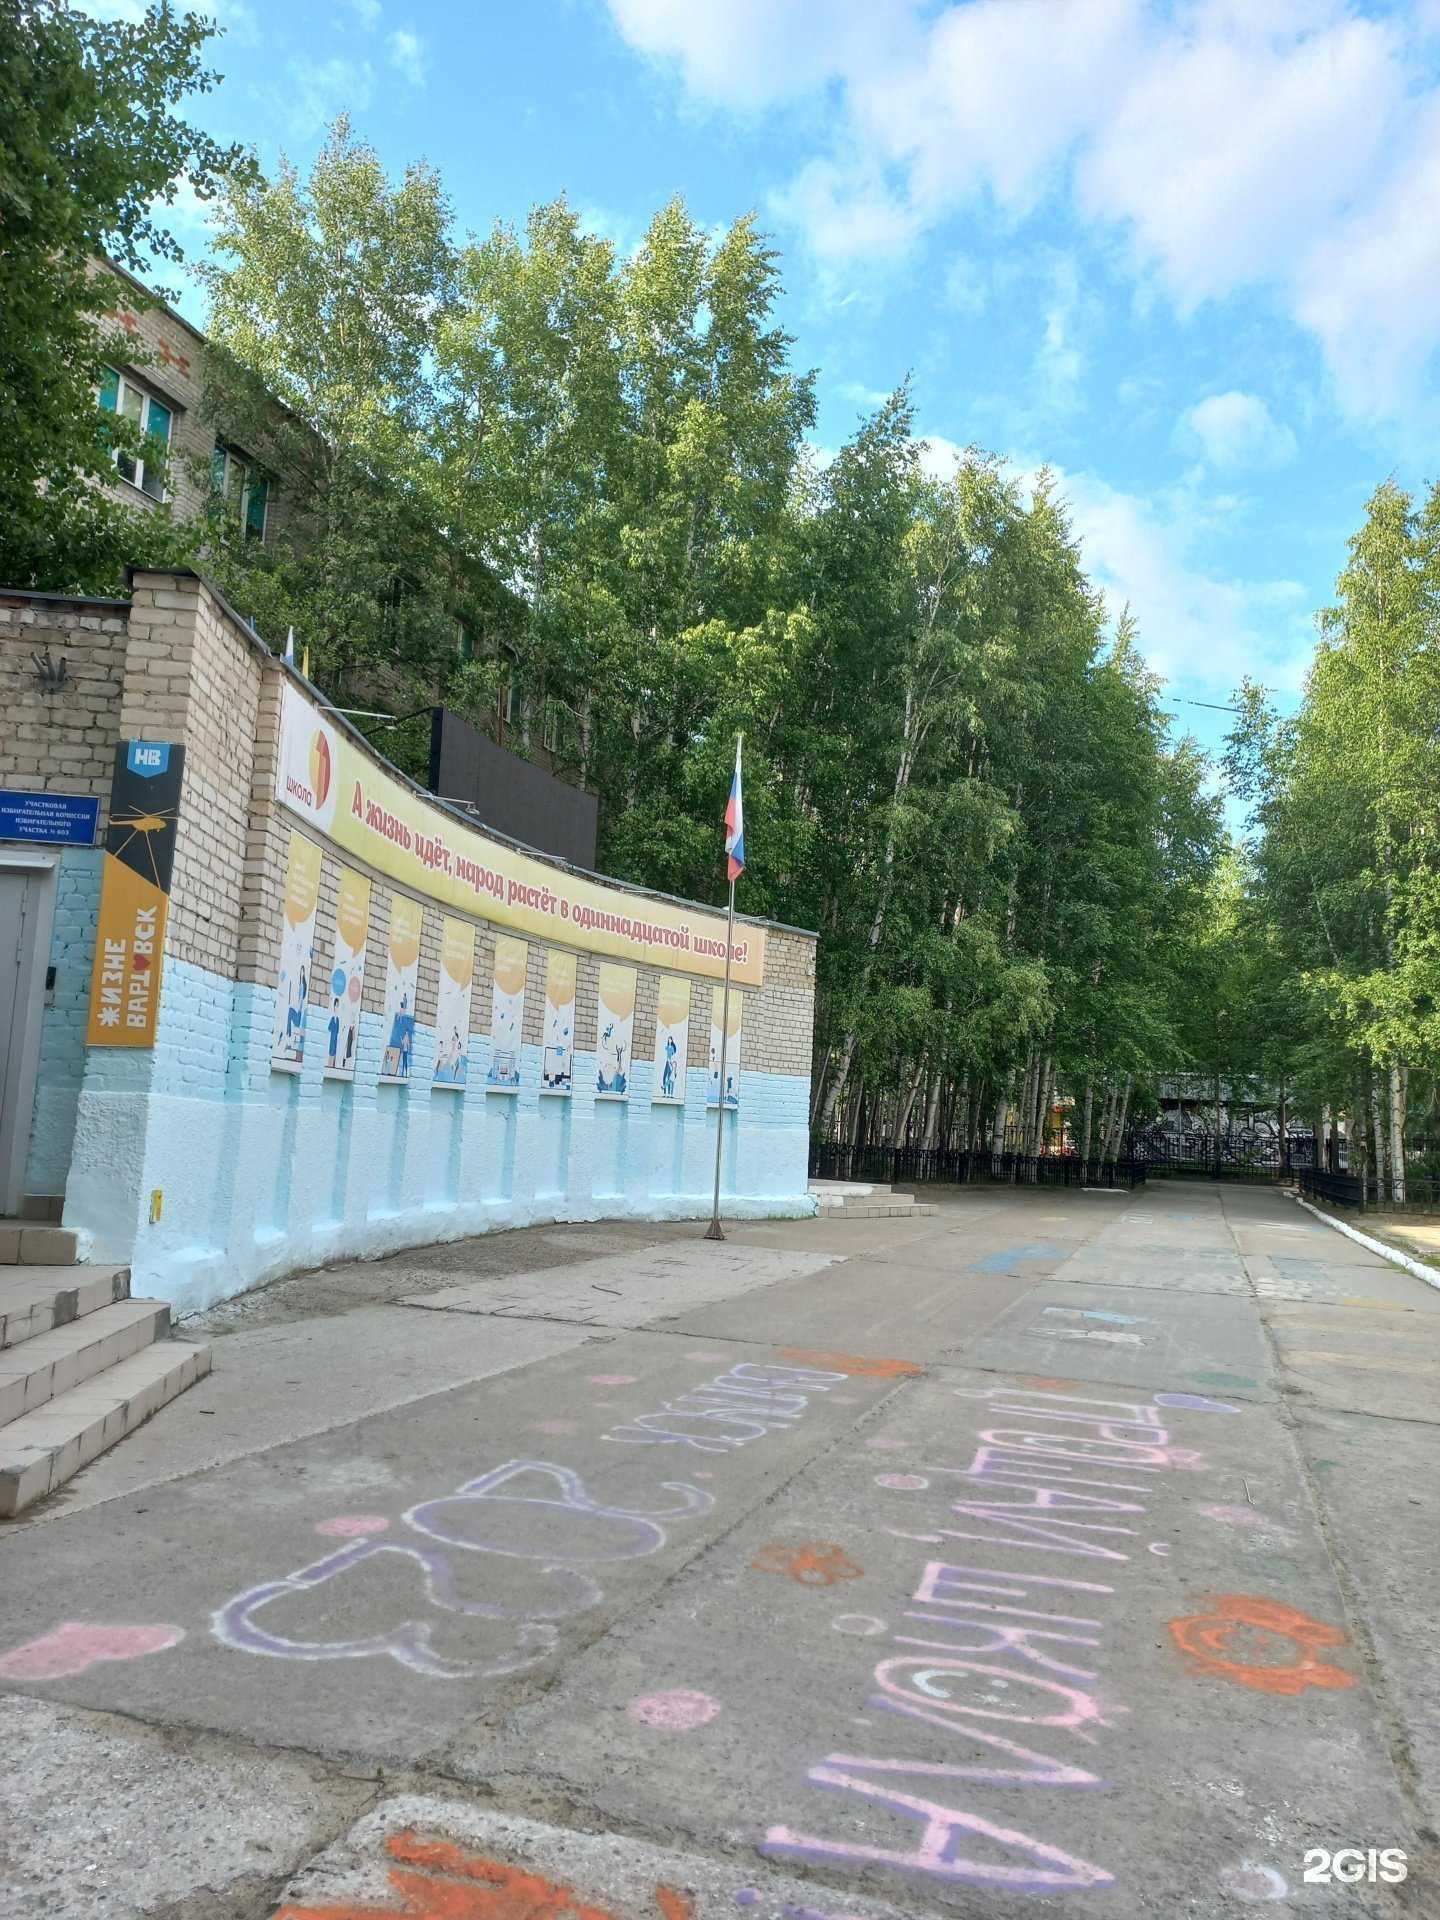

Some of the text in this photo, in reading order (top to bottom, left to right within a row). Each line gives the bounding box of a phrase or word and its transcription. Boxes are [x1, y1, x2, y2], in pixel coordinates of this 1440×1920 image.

[135, 748, 160, 766] НВ
[286, 776, 312, 807] школа
[352, 781, 362, 818] А
[365, 800, 411, 850] жизнь
[415, 833, 452, 875] идёт,
[456, 856, 504, 900] народ
[508, 879, 558, 915] растёт
[560, 902, 569, 918] в
[572, 903, 690, 950] одиннадцатой
[210, 1459, 716, 1679] 2023
